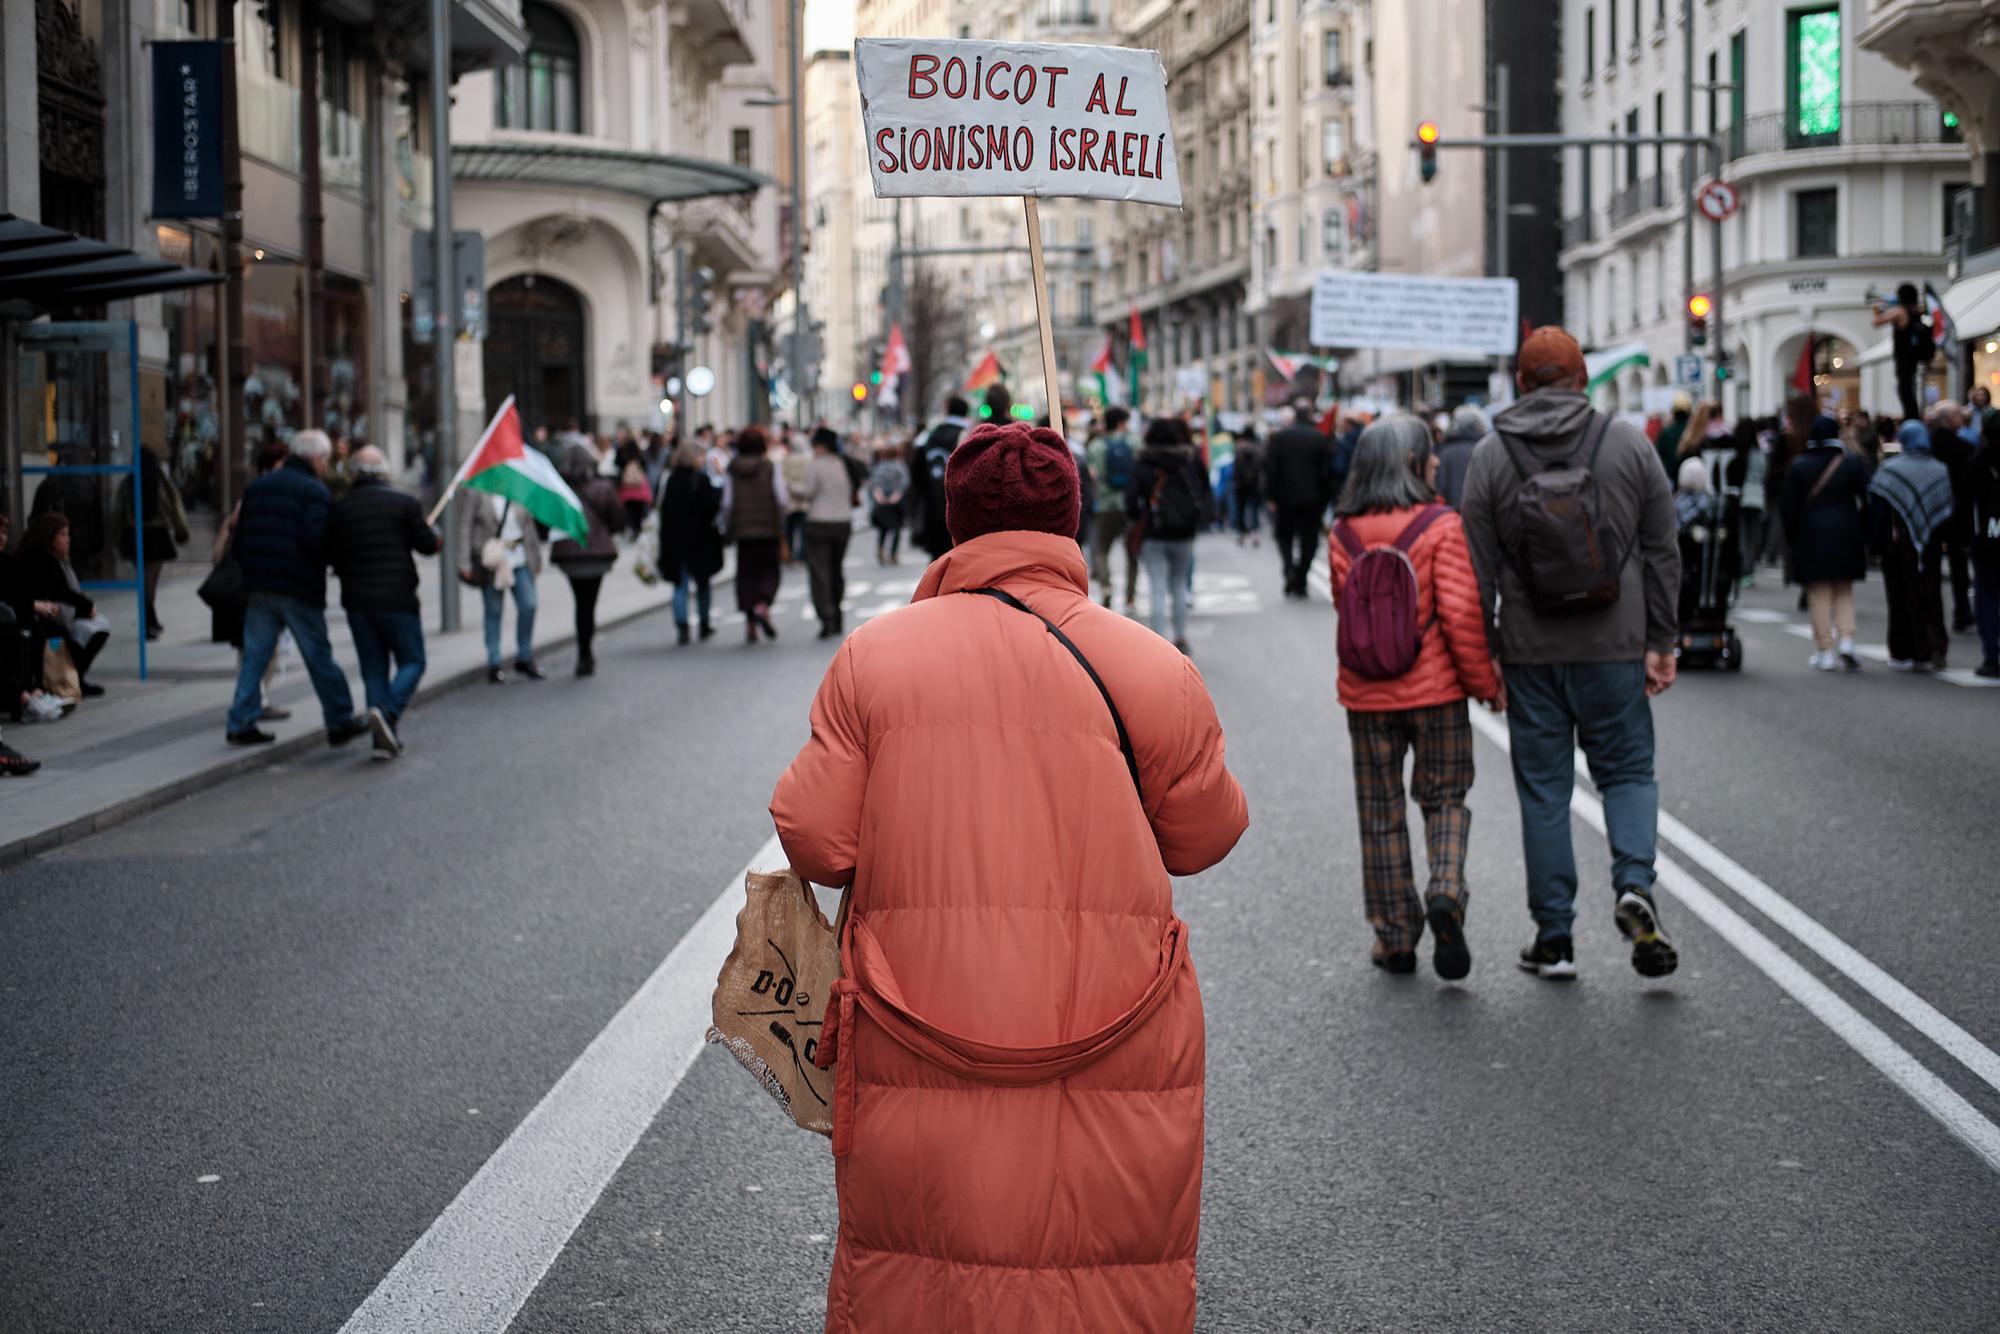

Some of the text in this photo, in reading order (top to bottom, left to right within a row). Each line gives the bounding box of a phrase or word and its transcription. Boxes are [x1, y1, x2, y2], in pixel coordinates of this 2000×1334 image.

[908, 54, 1137, 116] BOICOT AL
[183, 76, 199, 200] IBEROSTAR
[876, 124, 1166, 180] SIONISMO ISRAELÍ
